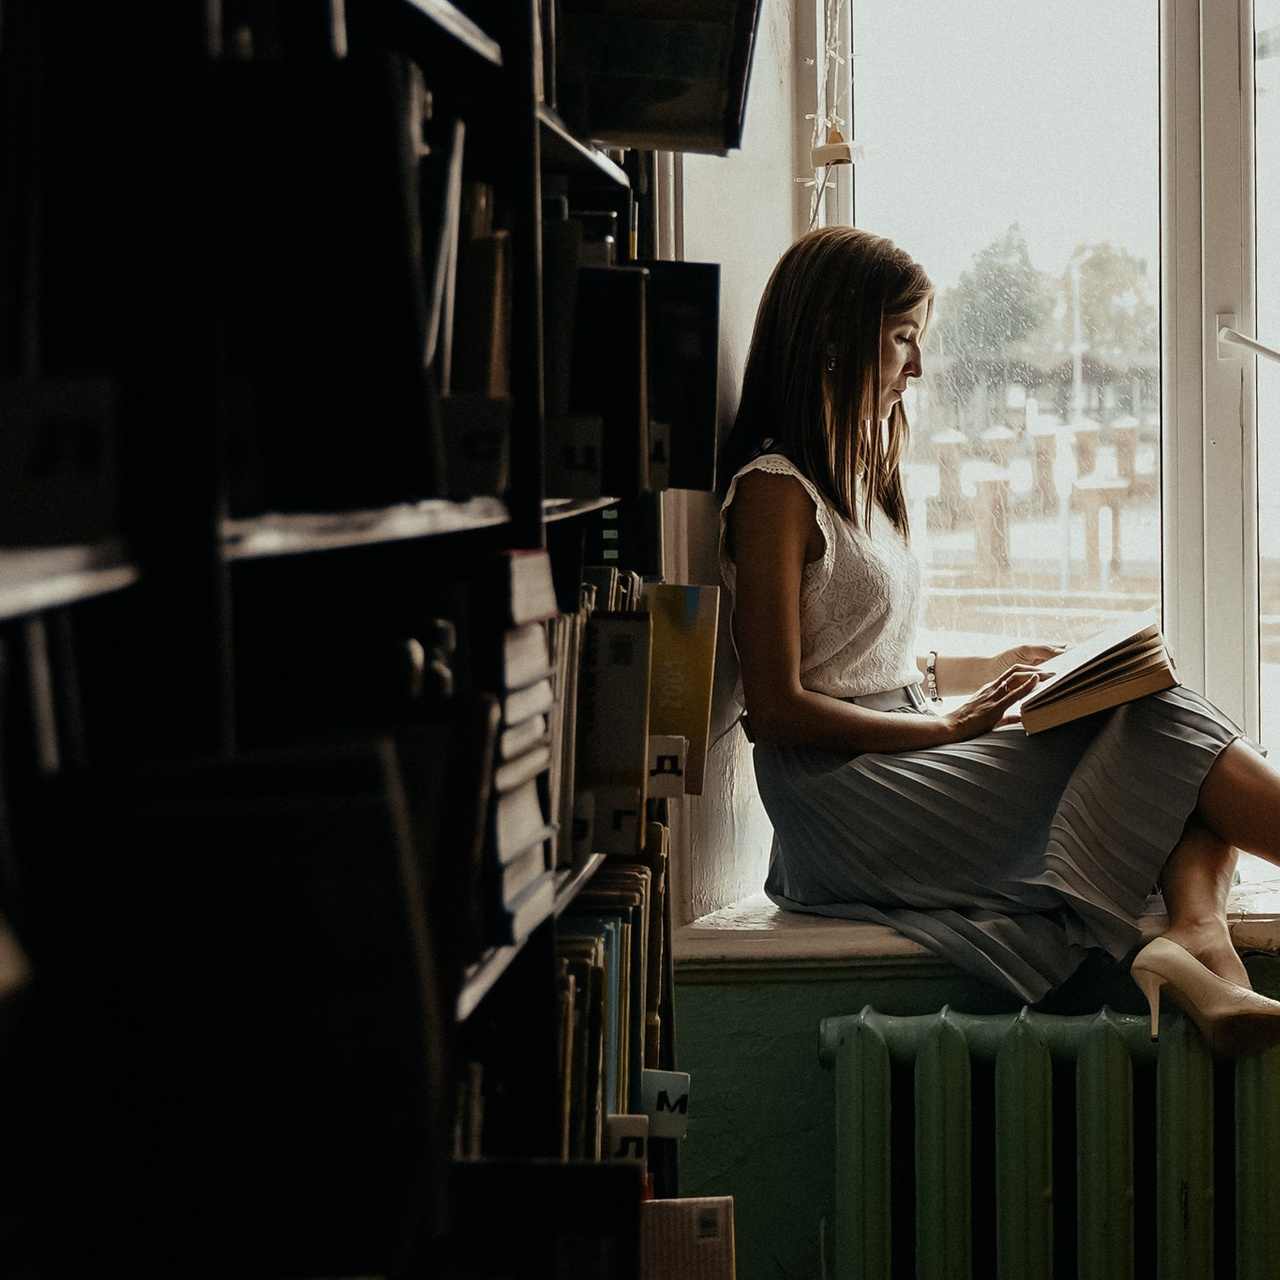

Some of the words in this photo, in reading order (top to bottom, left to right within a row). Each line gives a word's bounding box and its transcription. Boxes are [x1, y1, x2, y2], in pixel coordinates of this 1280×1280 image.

[650, 755, 682, 776] Д
[657, 1090, 688, 1114] М
[615, 1136, 643, 1158] Л
